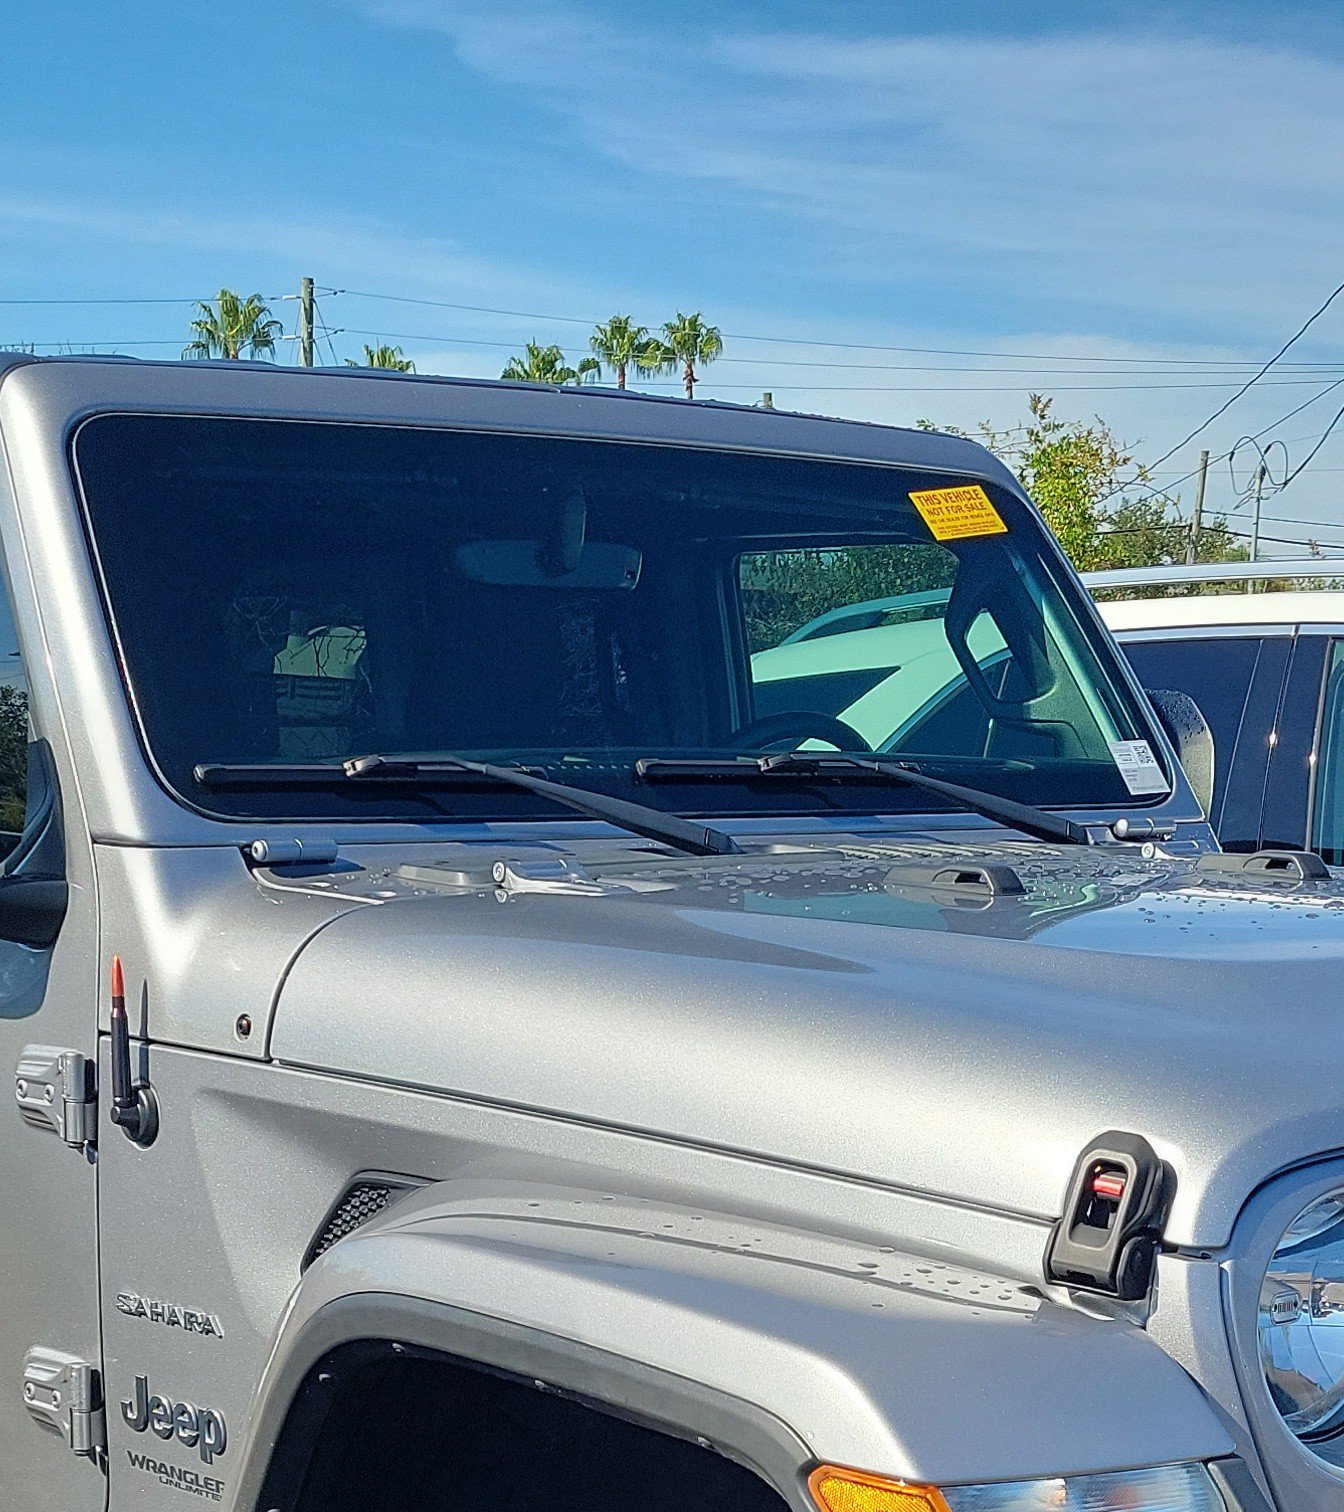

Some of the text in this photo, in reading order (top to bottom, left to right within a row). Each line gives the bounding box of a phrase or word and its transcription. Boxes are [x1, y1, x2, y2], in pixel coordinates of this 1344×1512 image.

[916, 488, 983, 507] THIS VEHICLE
[926, 502, 988, 517] NOT FOR SALE
[115, 1292, 225, 1339] SAHARA
[120, 1374, 227, 1466] Jeep
[159, 1476, 223, 1502] UNLIMITE
